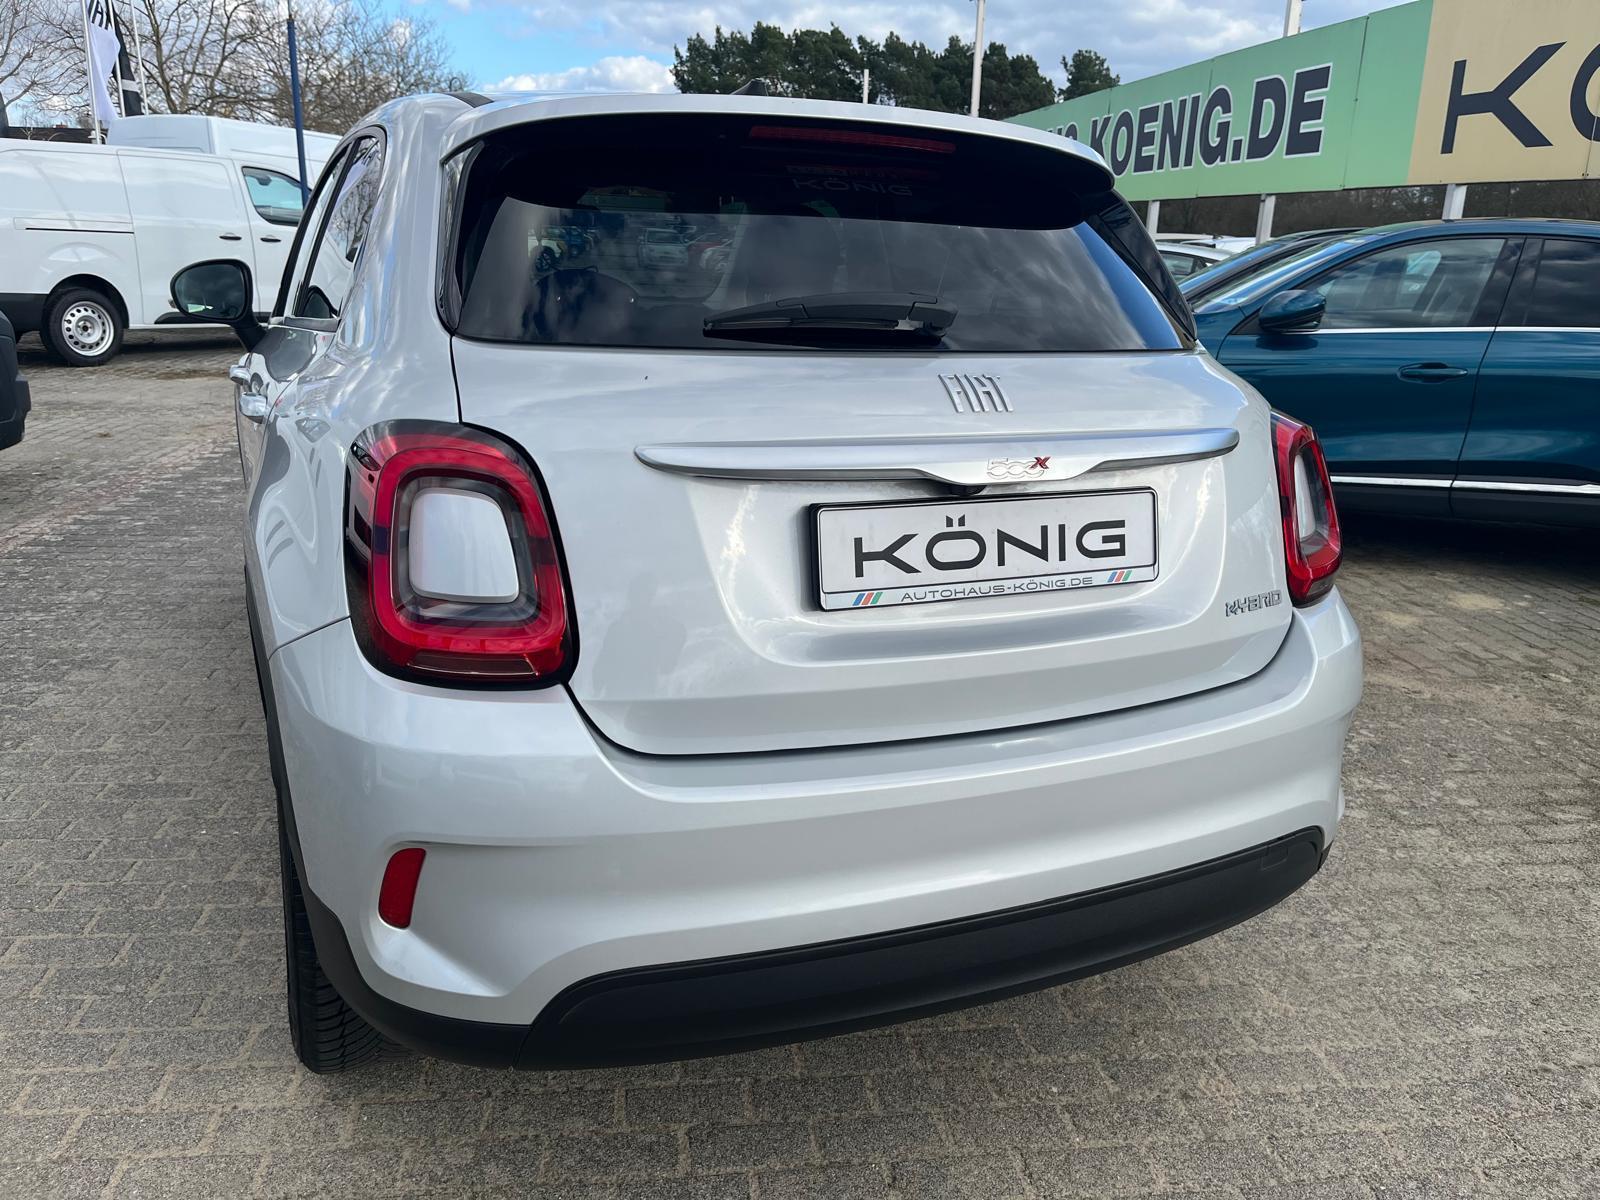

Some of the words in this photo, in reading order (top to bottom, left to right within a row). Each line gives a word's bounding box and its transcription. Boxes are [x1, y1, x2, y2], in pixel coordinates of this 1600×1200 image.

[1047, 63, 1333, 178] KOENIG.DE
[792, 177, 912, 197] KÖNIG
[938, 374, 1014, 413] FIAT
[854, 514, 1126, 577] KÖNIG
[900, 576, 1094, 602] AUTOHAUS-KÖNIG.DE
[1225, 590, 1281, 617] HYBRID
